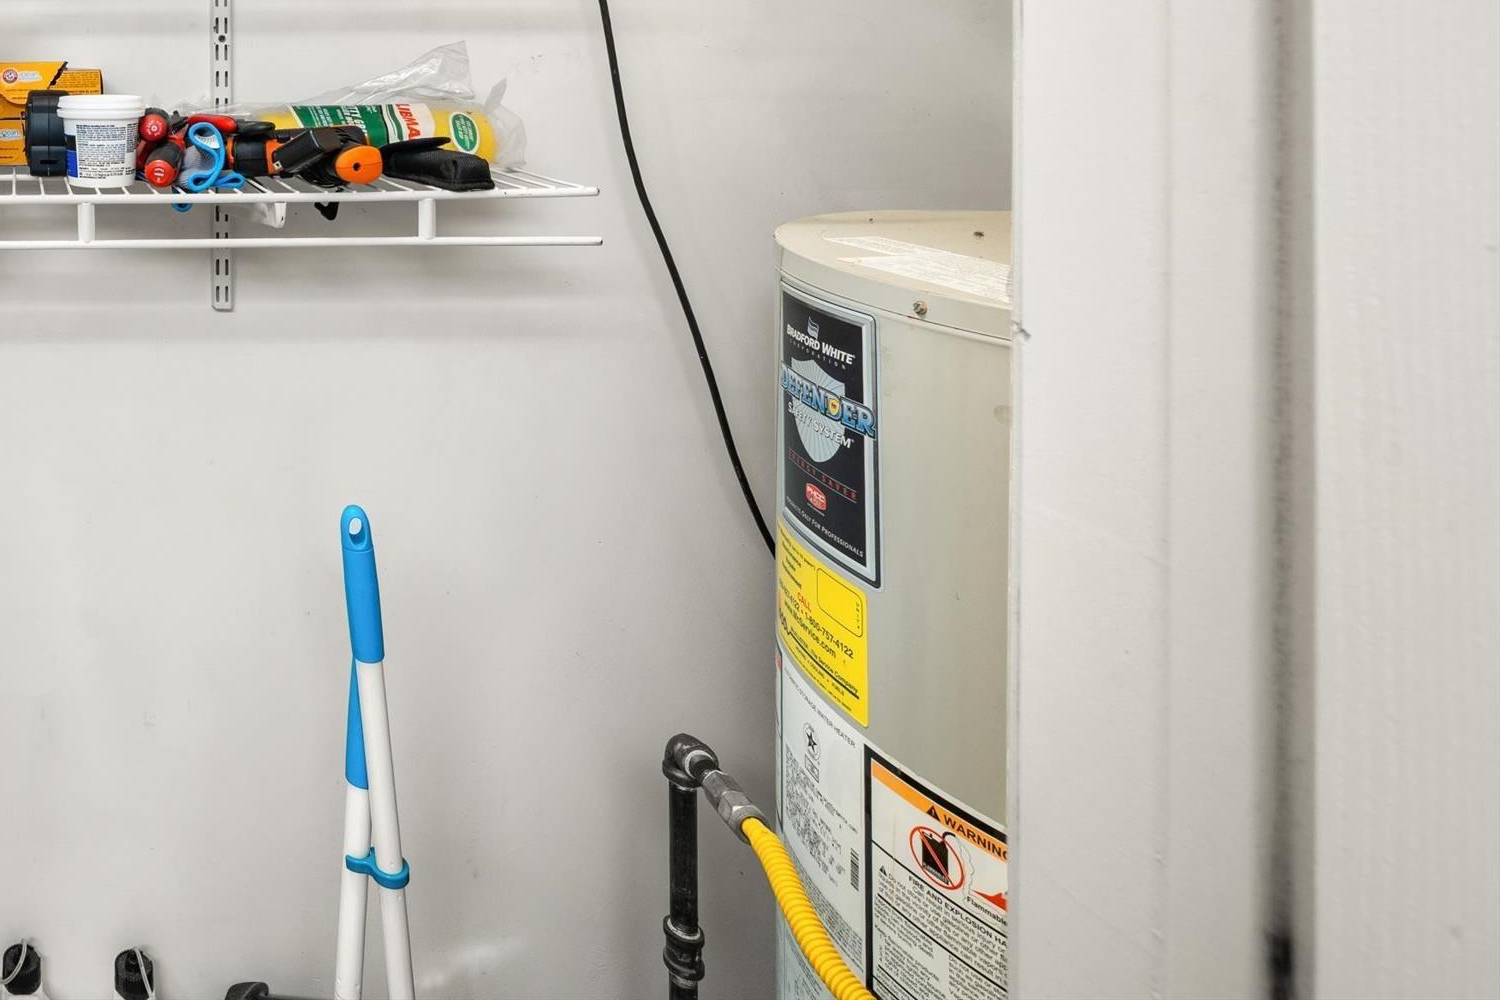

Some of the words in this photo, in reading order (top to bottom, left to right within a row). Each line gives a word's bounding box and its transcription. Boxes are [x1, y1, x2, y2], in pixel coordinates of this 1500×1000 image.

[786, 323, 820, 350] BRADFORD
[821, 341, 853, 365] WHITE
[780, 361, 876, 439] DEFENDER
[812, 420, 851, 449] SYSTEM
[821, 525, 864, 558] PROFESSIONALS
[908, 874, 925, 893] FIRE
[926, 887, 942, 904] AND
[944, 899, 992, 940] EXPLOSION
